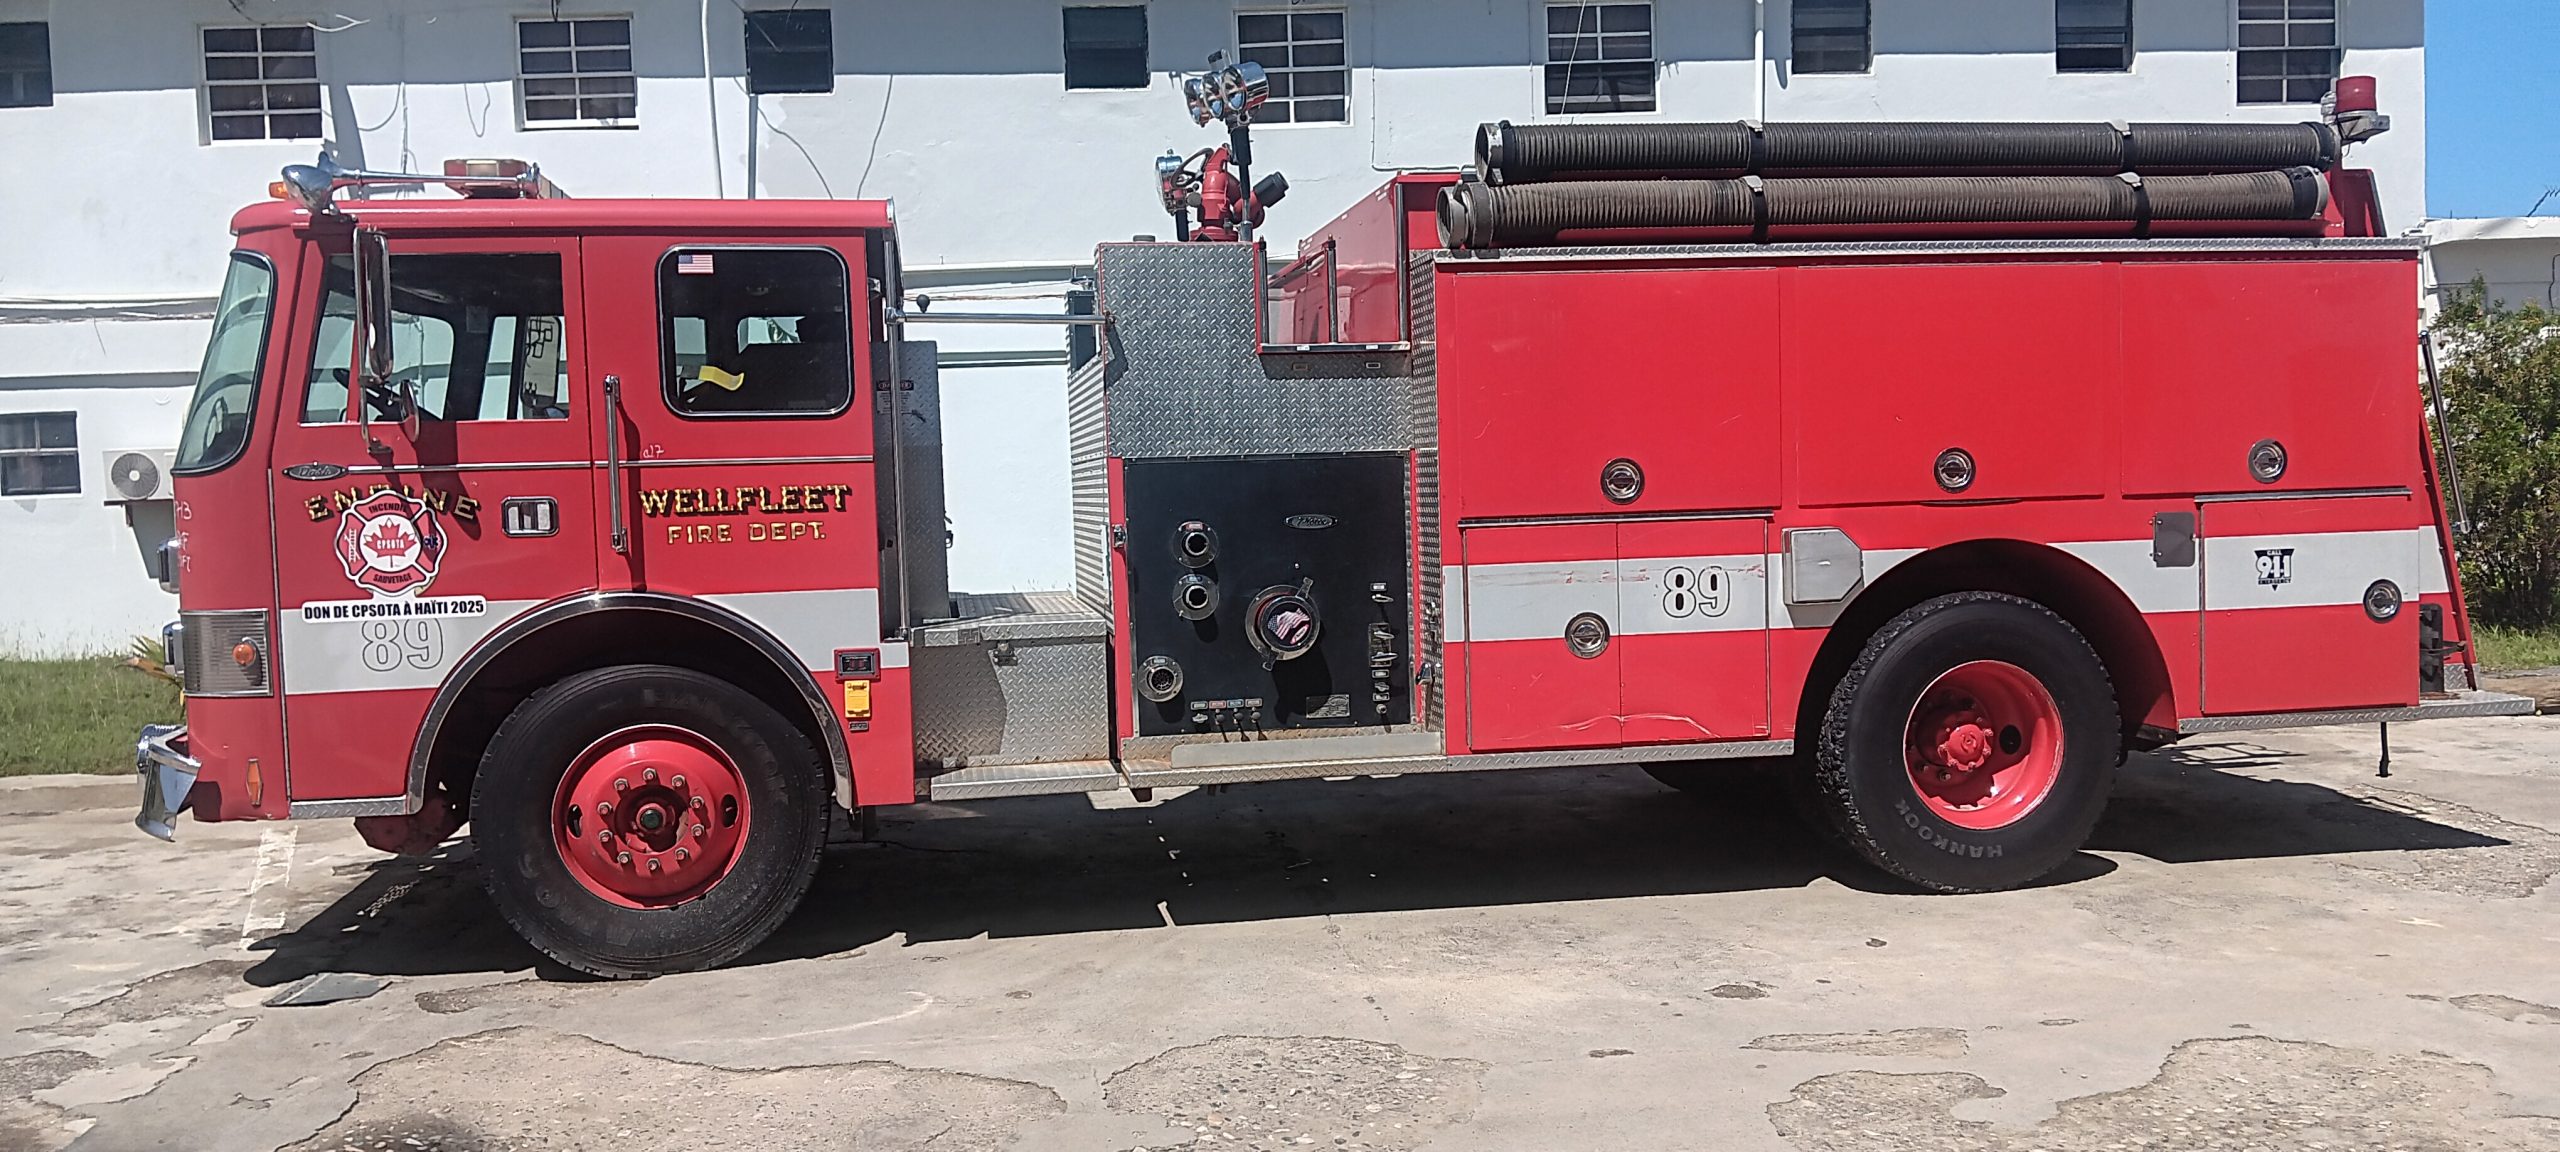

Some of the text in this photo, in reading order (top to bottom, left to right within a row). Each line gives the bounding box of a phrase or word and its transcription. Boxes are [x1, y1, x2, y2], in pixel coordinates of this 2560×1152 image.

[305, 484, 479, 521] ENINE
[639, 484, 852, 517] WELLFLEET
[377, 539, 404, 549] CPSOTA
[667, 520, 827, 544] FIRE DEPT.
[373, 573, 412, 584] SAUVETAGE
[1663, 566, 1730, 618] 89
[304, 600, 484, 620] DON DE CPSOTA À HAÏTI 2025
[361, 617, 444, 672] 89
[1894, 799, 2003, 858] HANKOOK
